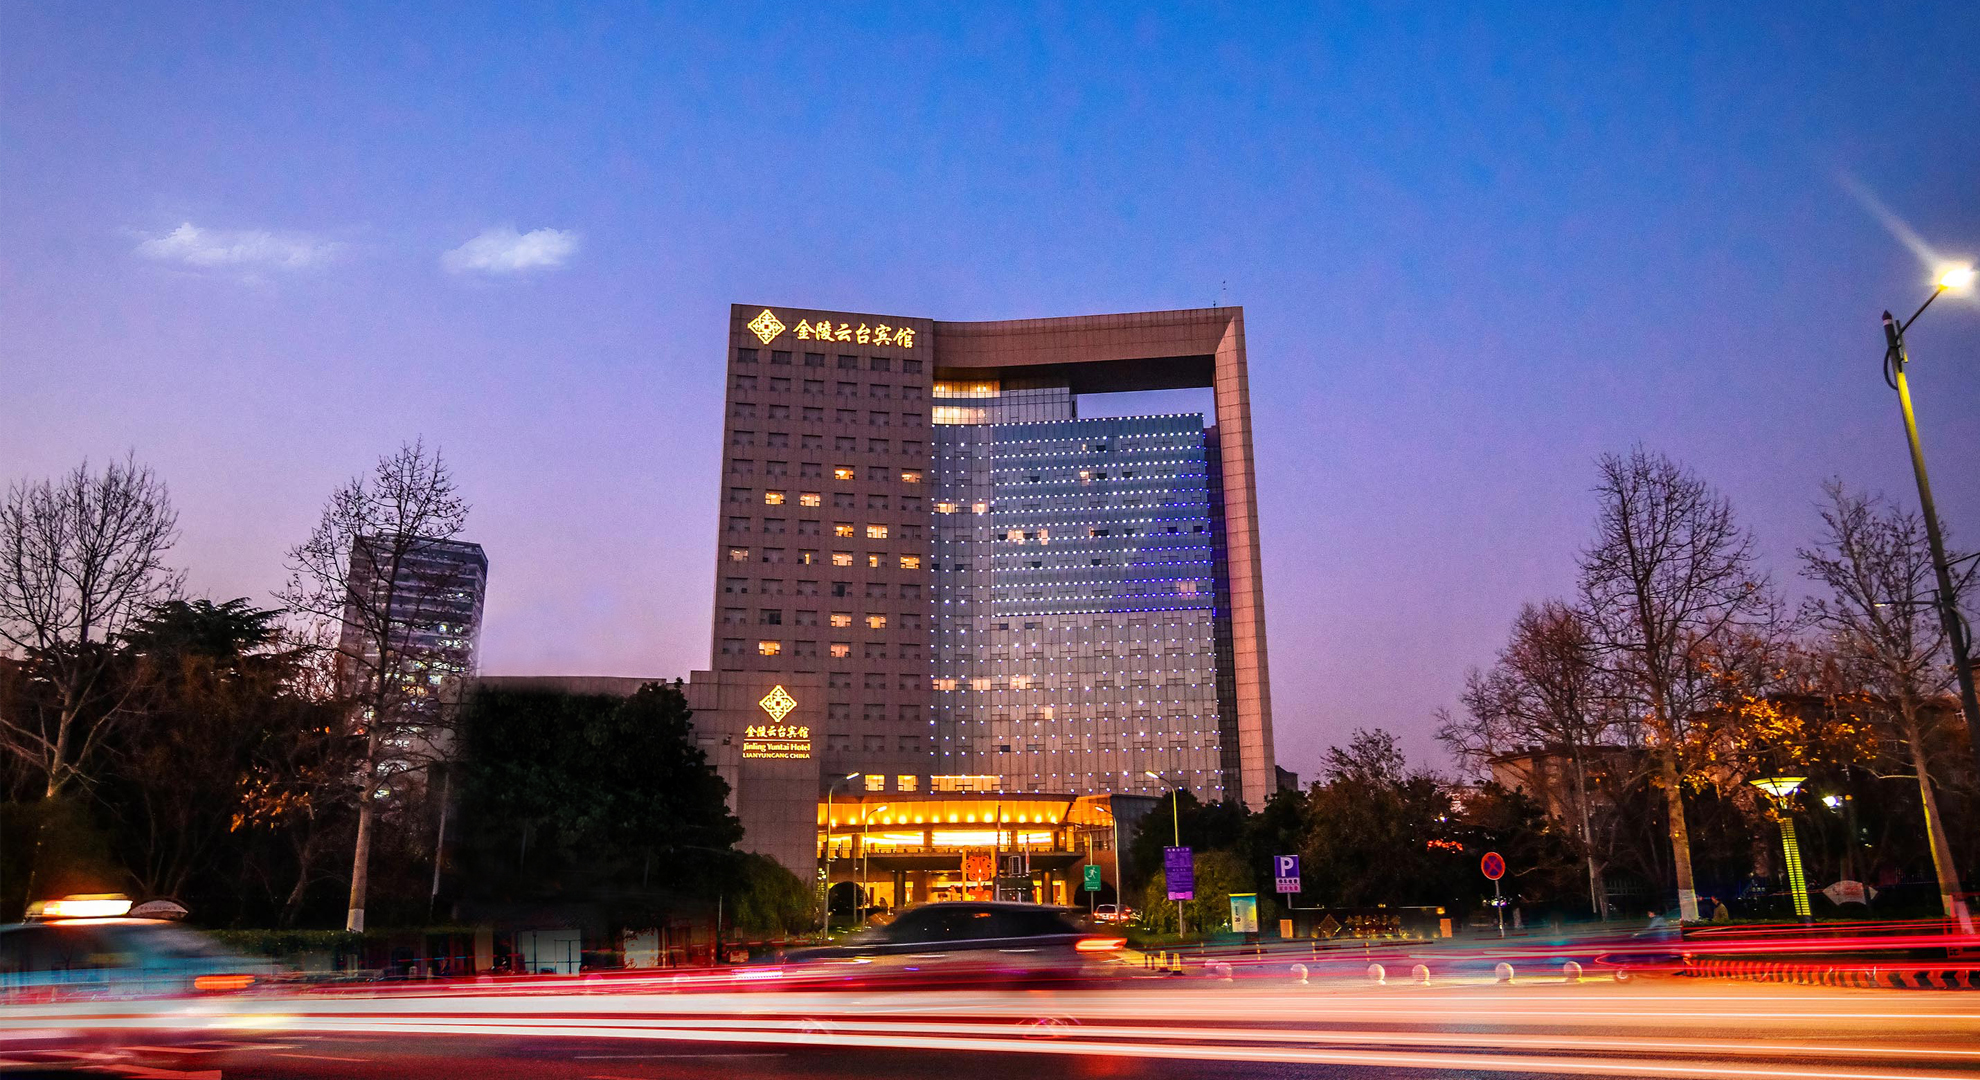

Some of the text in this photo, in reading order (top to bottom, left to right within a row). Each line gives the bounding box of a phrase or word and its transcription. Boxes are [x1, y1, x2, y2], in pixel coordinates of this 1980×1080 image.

[792, 318, 916, 349] 金陵云台宾馆
[744, 725, 810, 738] 金陵云台宾馆
[743, 742, 810, 752] Jinling Yuntai Hotel
[1280, 857, 1294, 877] P
